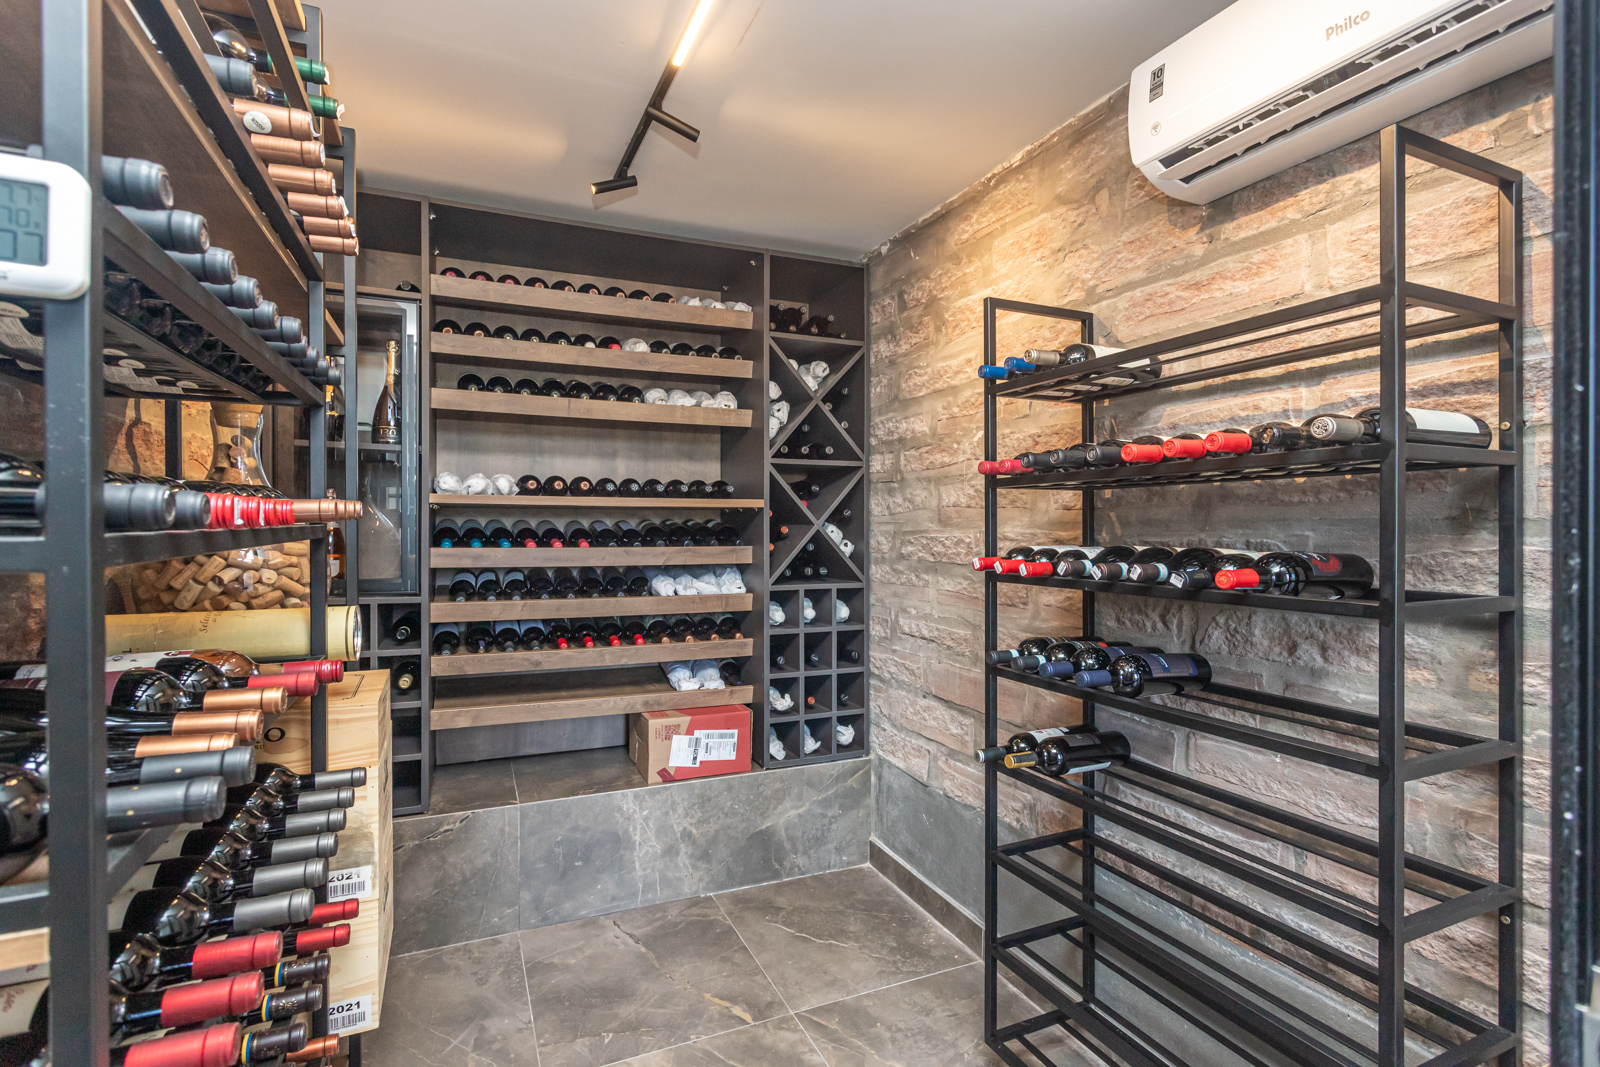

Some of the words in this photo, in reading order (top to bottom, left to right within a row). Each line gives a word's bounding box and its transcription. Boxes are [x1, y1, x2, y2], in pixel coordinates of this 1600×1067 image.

[1325, 10, 1370, 41] Philco
[1152, 67, 1163, 81] 10
[328, 1001, 360, 1016] 2021
